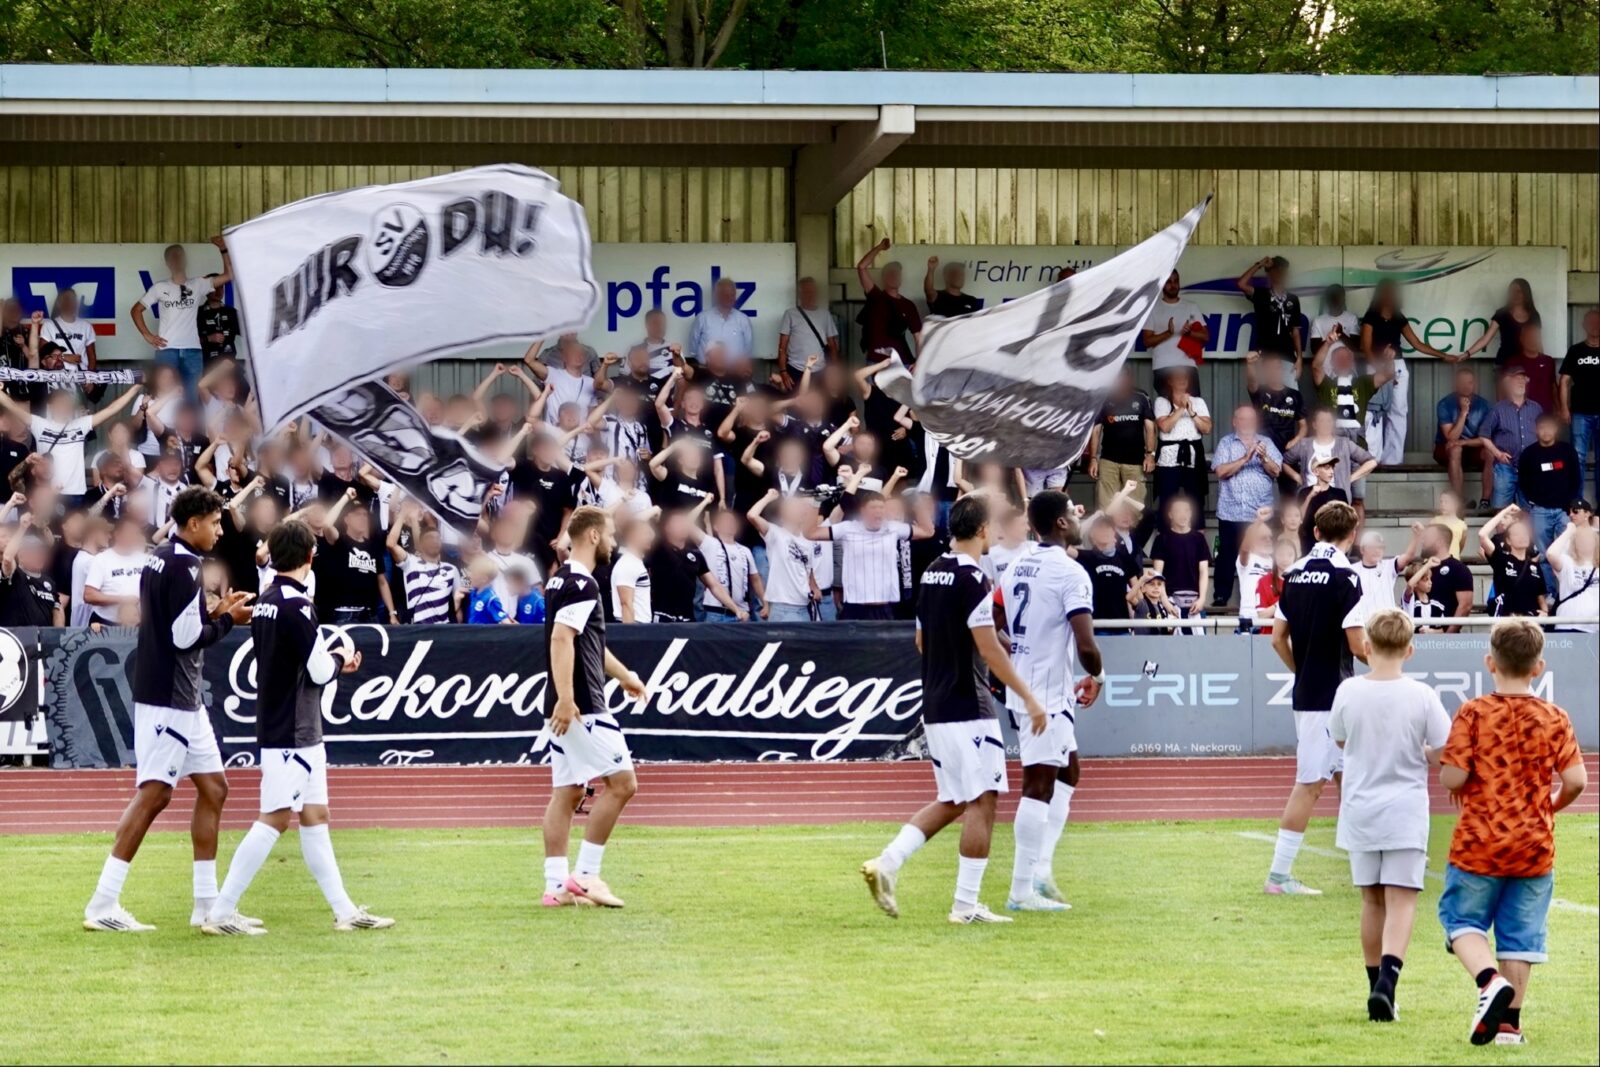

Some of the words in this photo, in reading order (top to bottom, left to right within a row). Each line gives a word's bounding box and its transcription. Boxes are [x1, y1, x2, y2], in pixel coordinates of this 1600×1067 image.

[375, 209, 405, 256] SV
[267, 234, 363, 347] NUR
[1014, 566, 1040, 578] SCHULZ
[1013, 582, 1030, 635] 2
[1130, 743, 1162, 753] 68169
[1165, 743, 1180, 752] MA
[1190, 743, 1242, 753] Neckarau
